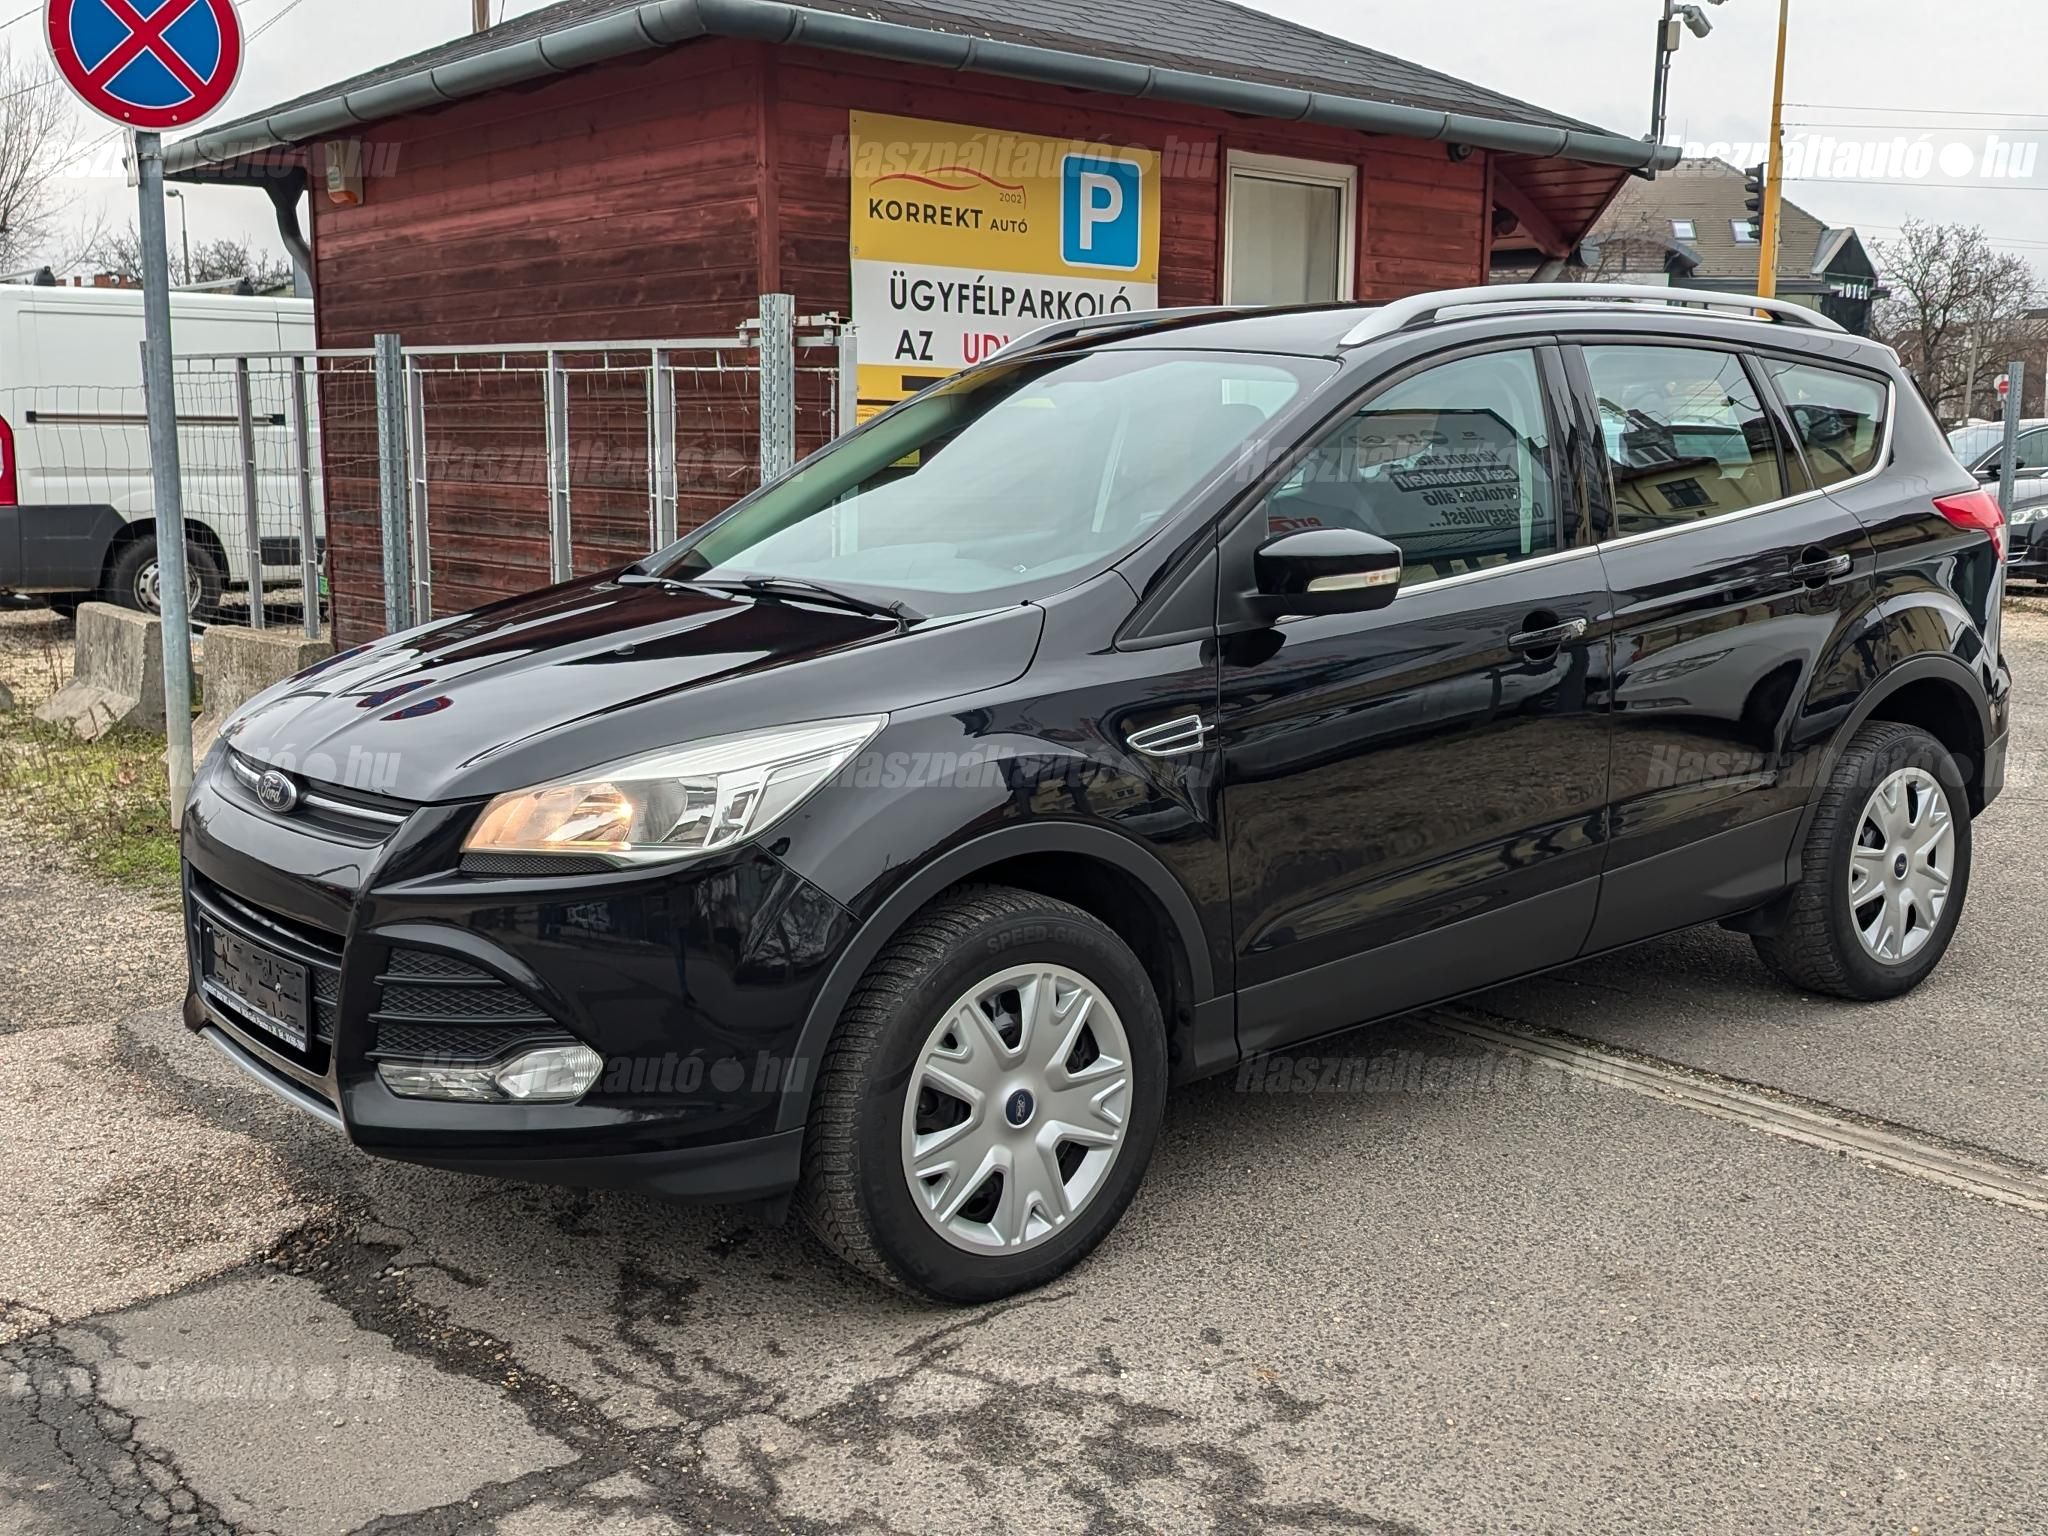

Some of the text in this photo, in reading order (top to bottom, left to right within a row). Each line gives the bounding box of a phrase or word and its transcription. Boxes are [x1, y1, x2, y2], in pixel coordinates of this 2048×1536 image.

[999, 192, 1022, 204] 2002
[1079, 171, 1123, 250] P
[868, 198, 1028, 234] KORREKT AUTÓ
[890, 270, 1131, 320] ÜGYFÉLPARKOLÓ
[1838, 283, 1868, 300] HOTEL
[895, 329, 934, 361] AZ
[261, 776, 284, 803] Ford
